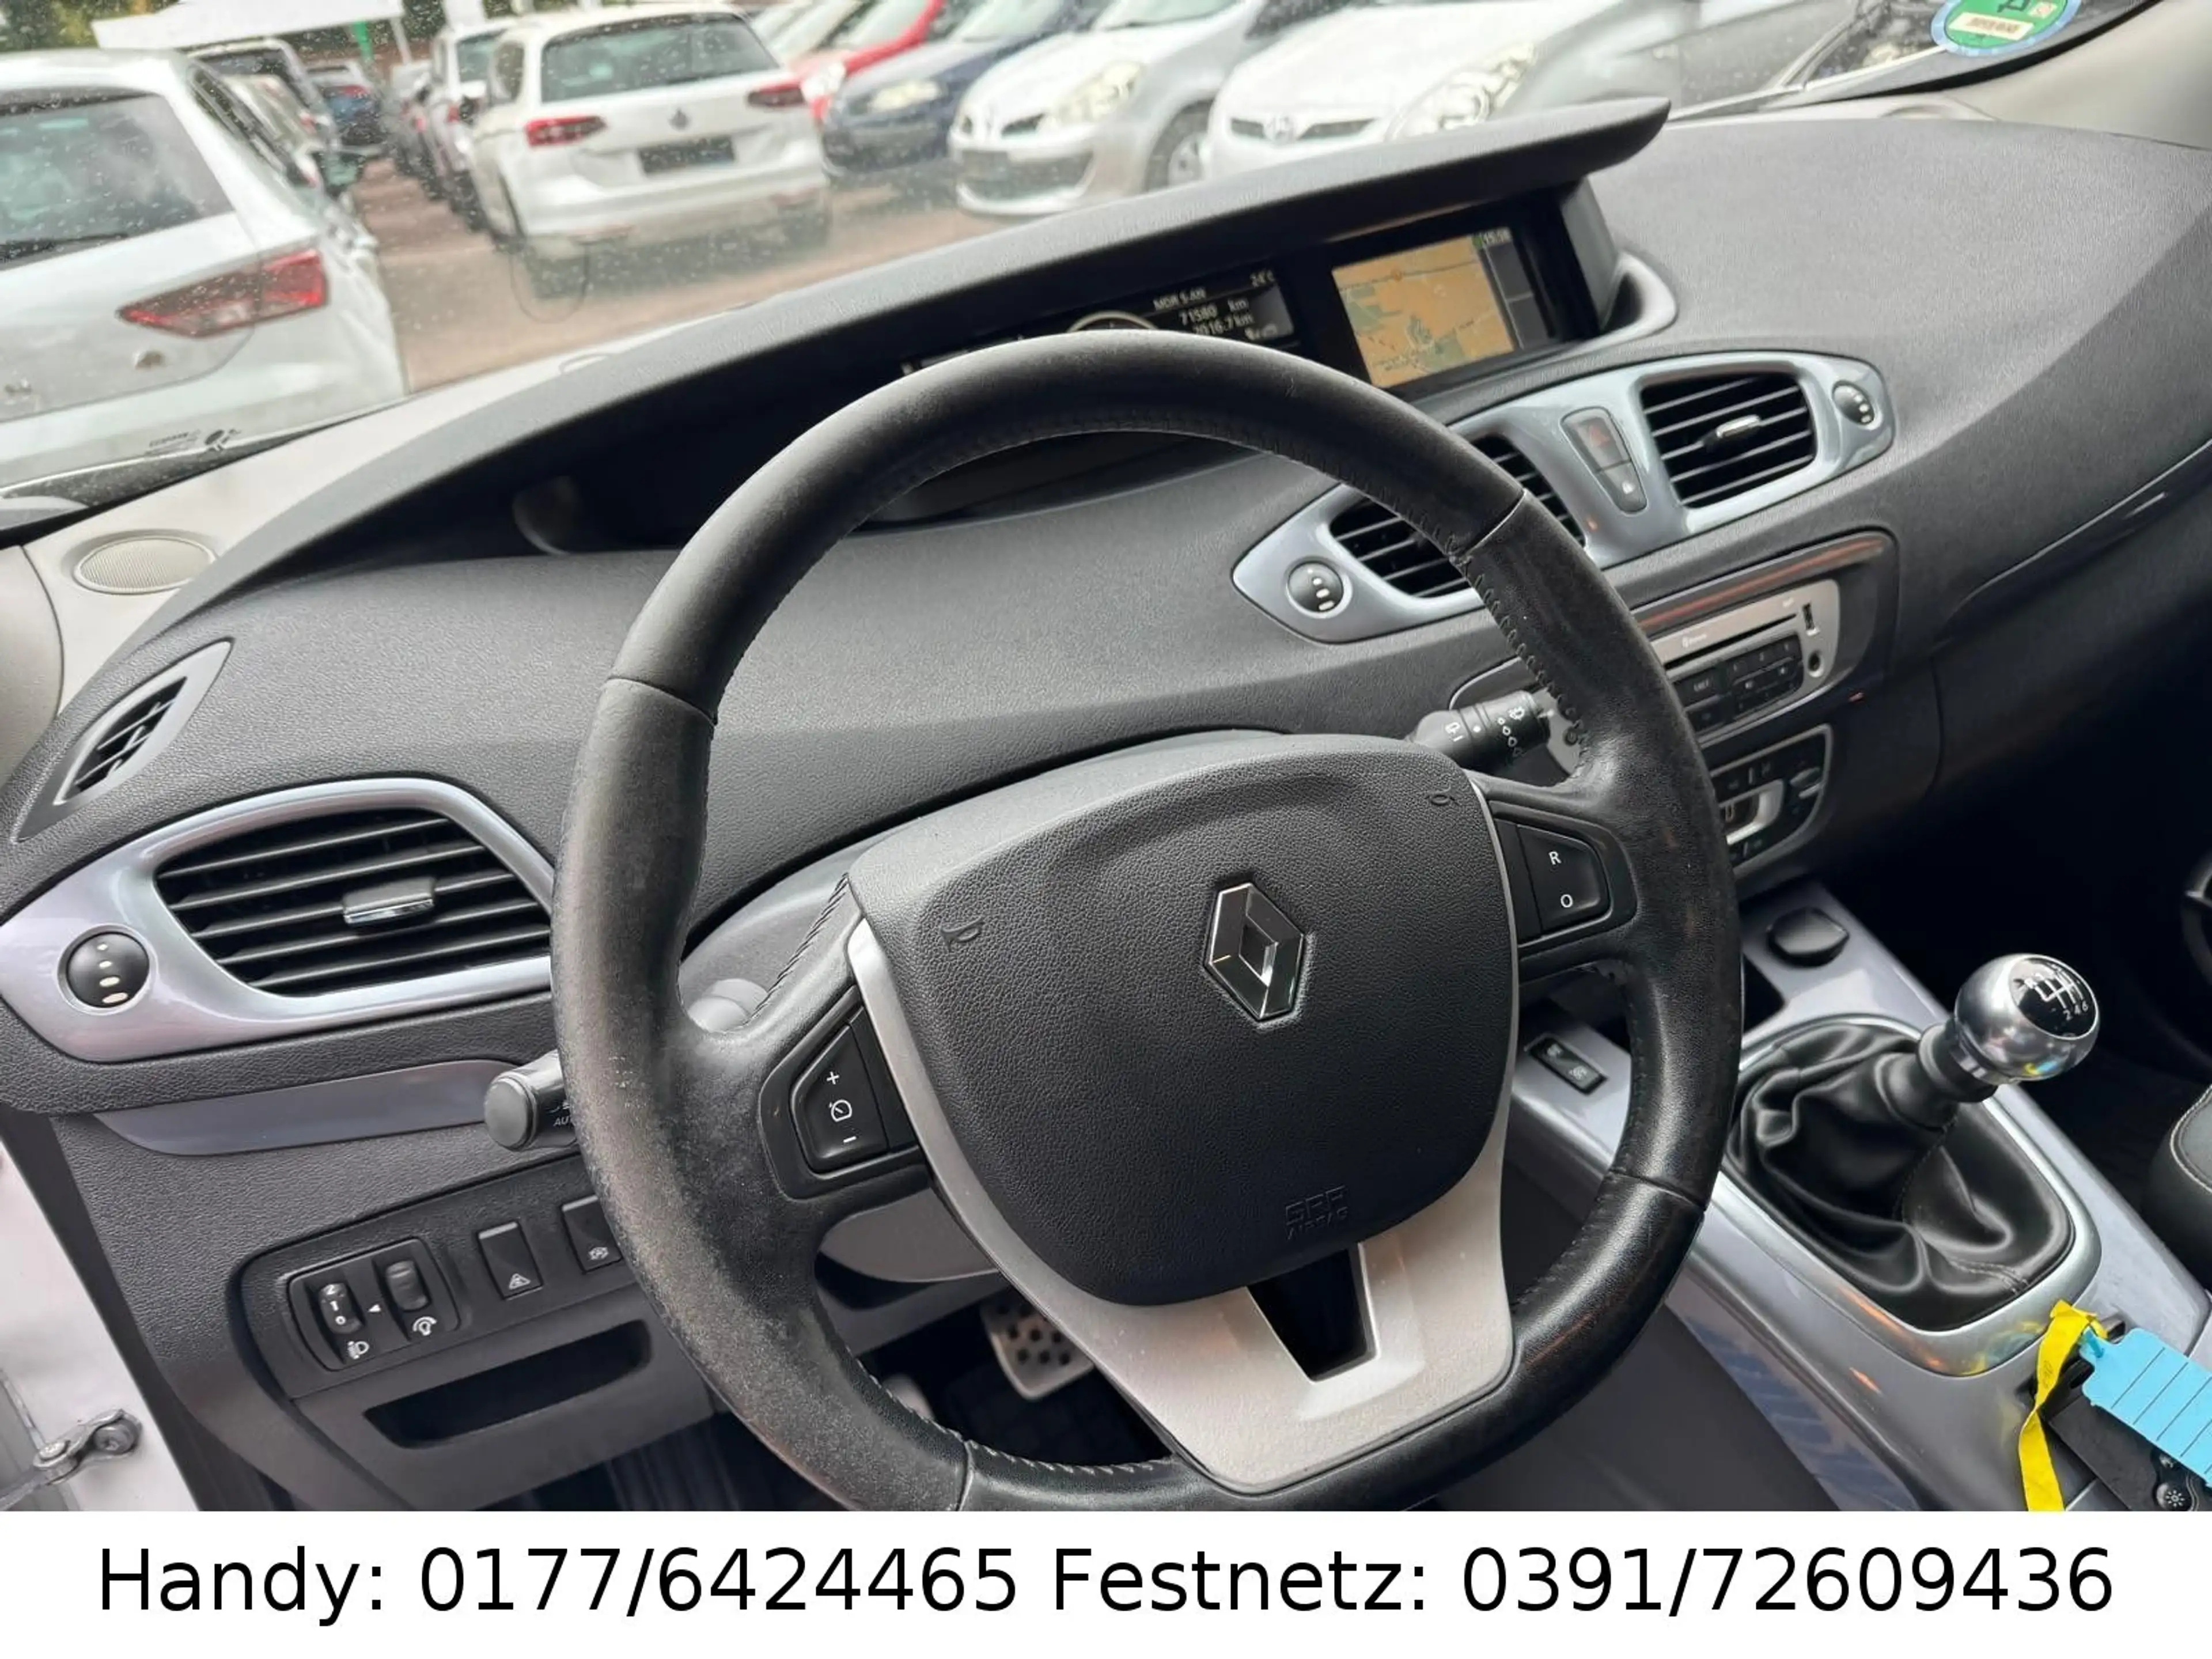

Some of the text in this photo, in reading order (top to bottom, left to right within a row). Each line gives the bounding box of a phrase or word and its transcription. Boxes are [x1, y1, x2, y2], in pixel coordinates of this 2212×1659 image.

[1548, 851, 1562, 865] R
[2063, 1009, 2073, 1021] 2
[2082, 1000, 2089, 1012] 6
[323, 1284, 336, 1296] 2
[329, 1300, 339, 1312] 1
